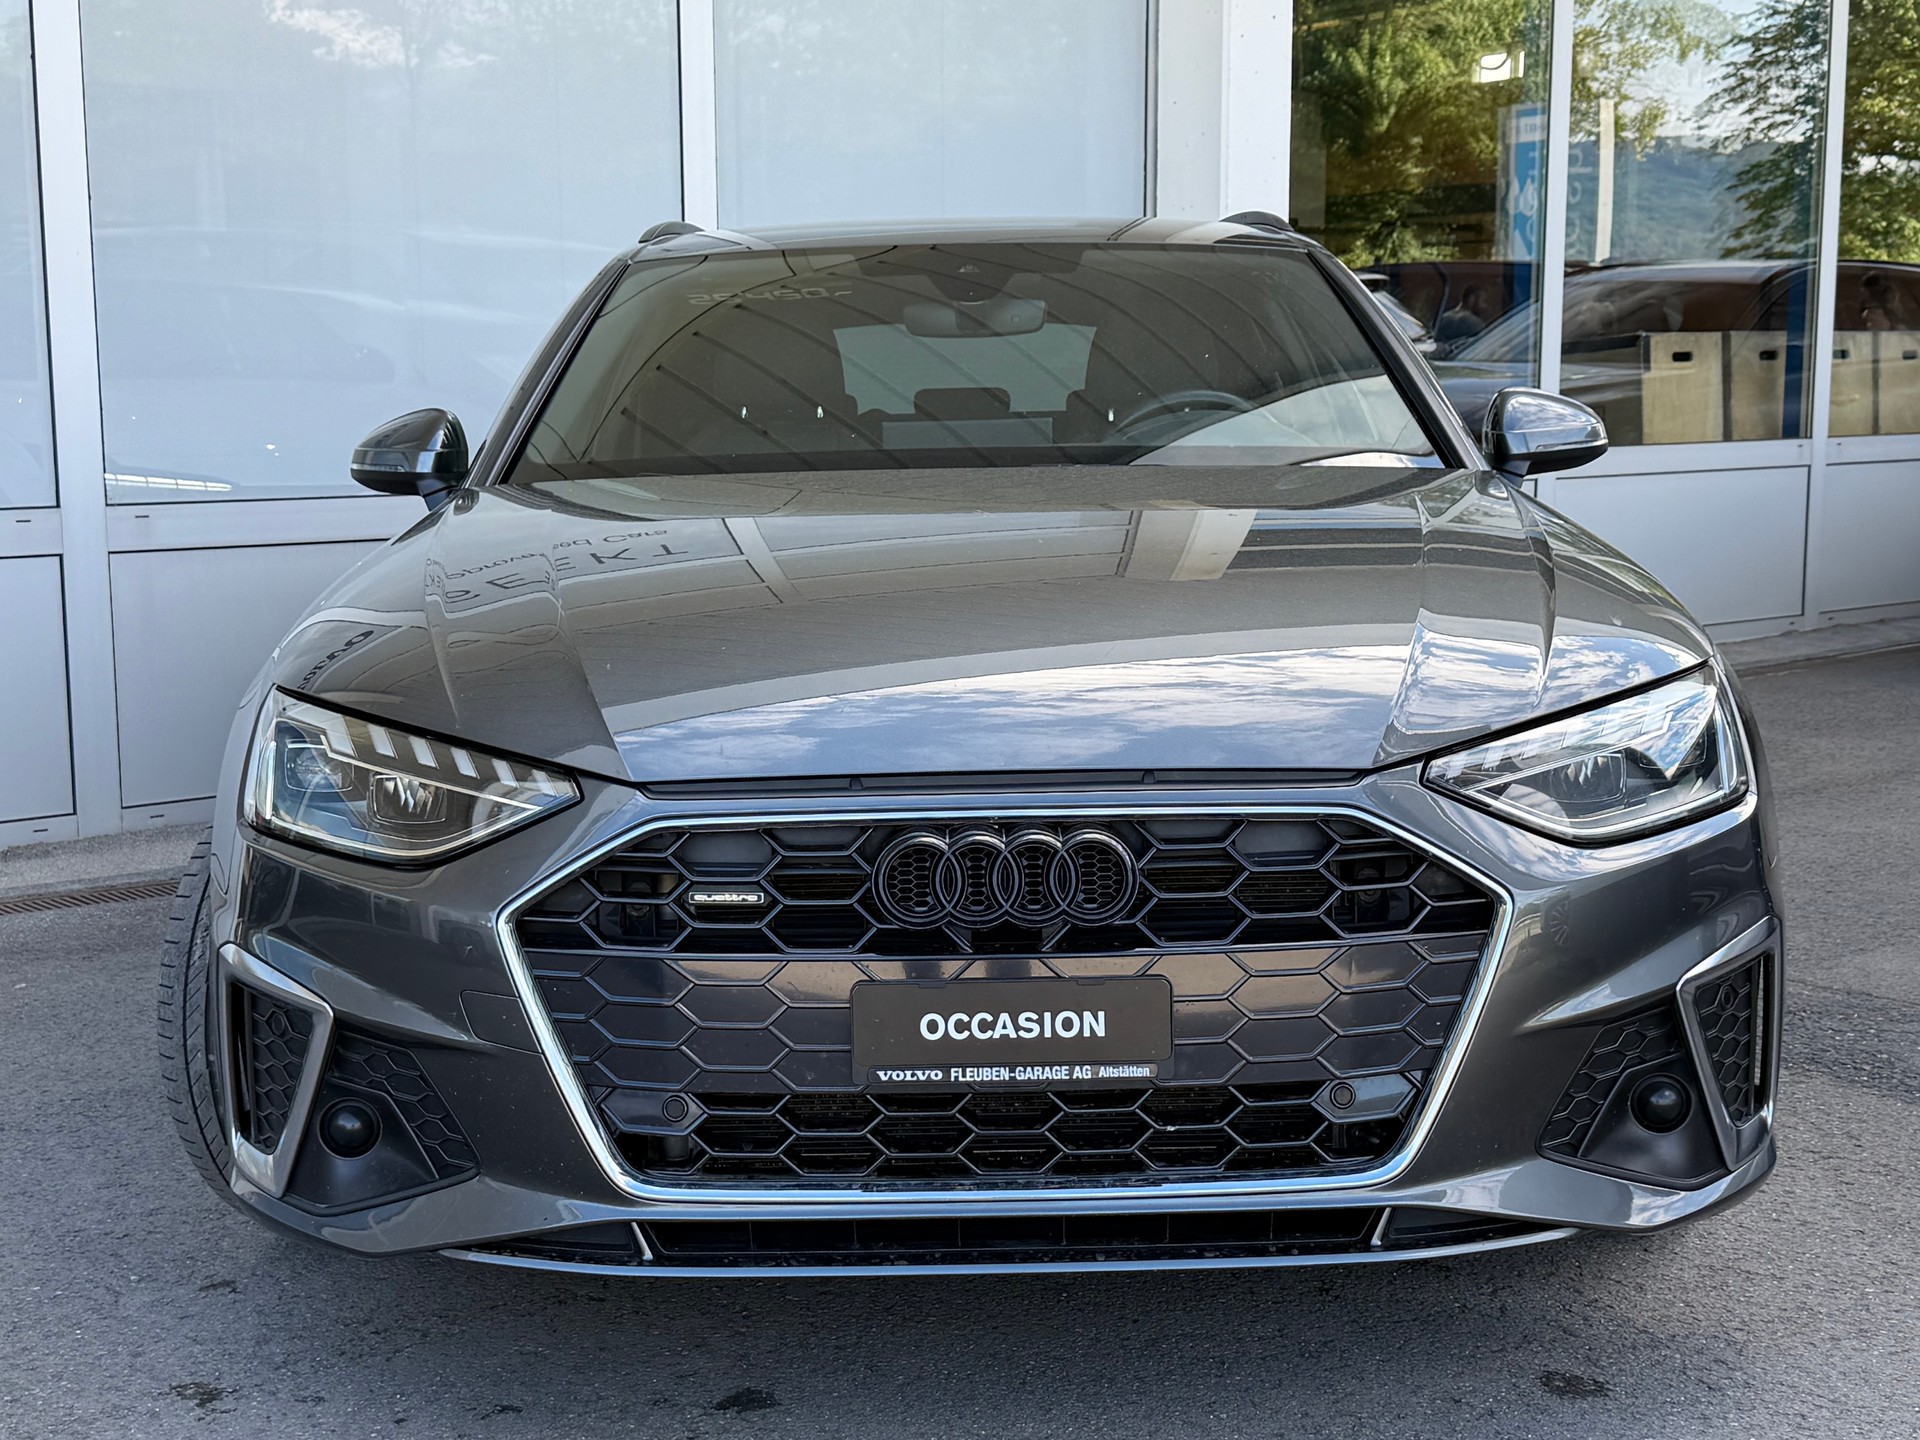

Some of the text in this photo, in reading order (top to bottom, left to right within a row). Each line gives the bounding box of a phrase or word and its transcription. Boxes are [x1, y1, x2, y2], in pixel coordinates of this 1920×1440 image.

[693, 893, 759, 903] quattro
[919, 1010, 1106, 1041] OCCASION
[876, 1065, 1151, 1082] VOLVO FLEUBEN-GARAGE AG Altstätten
